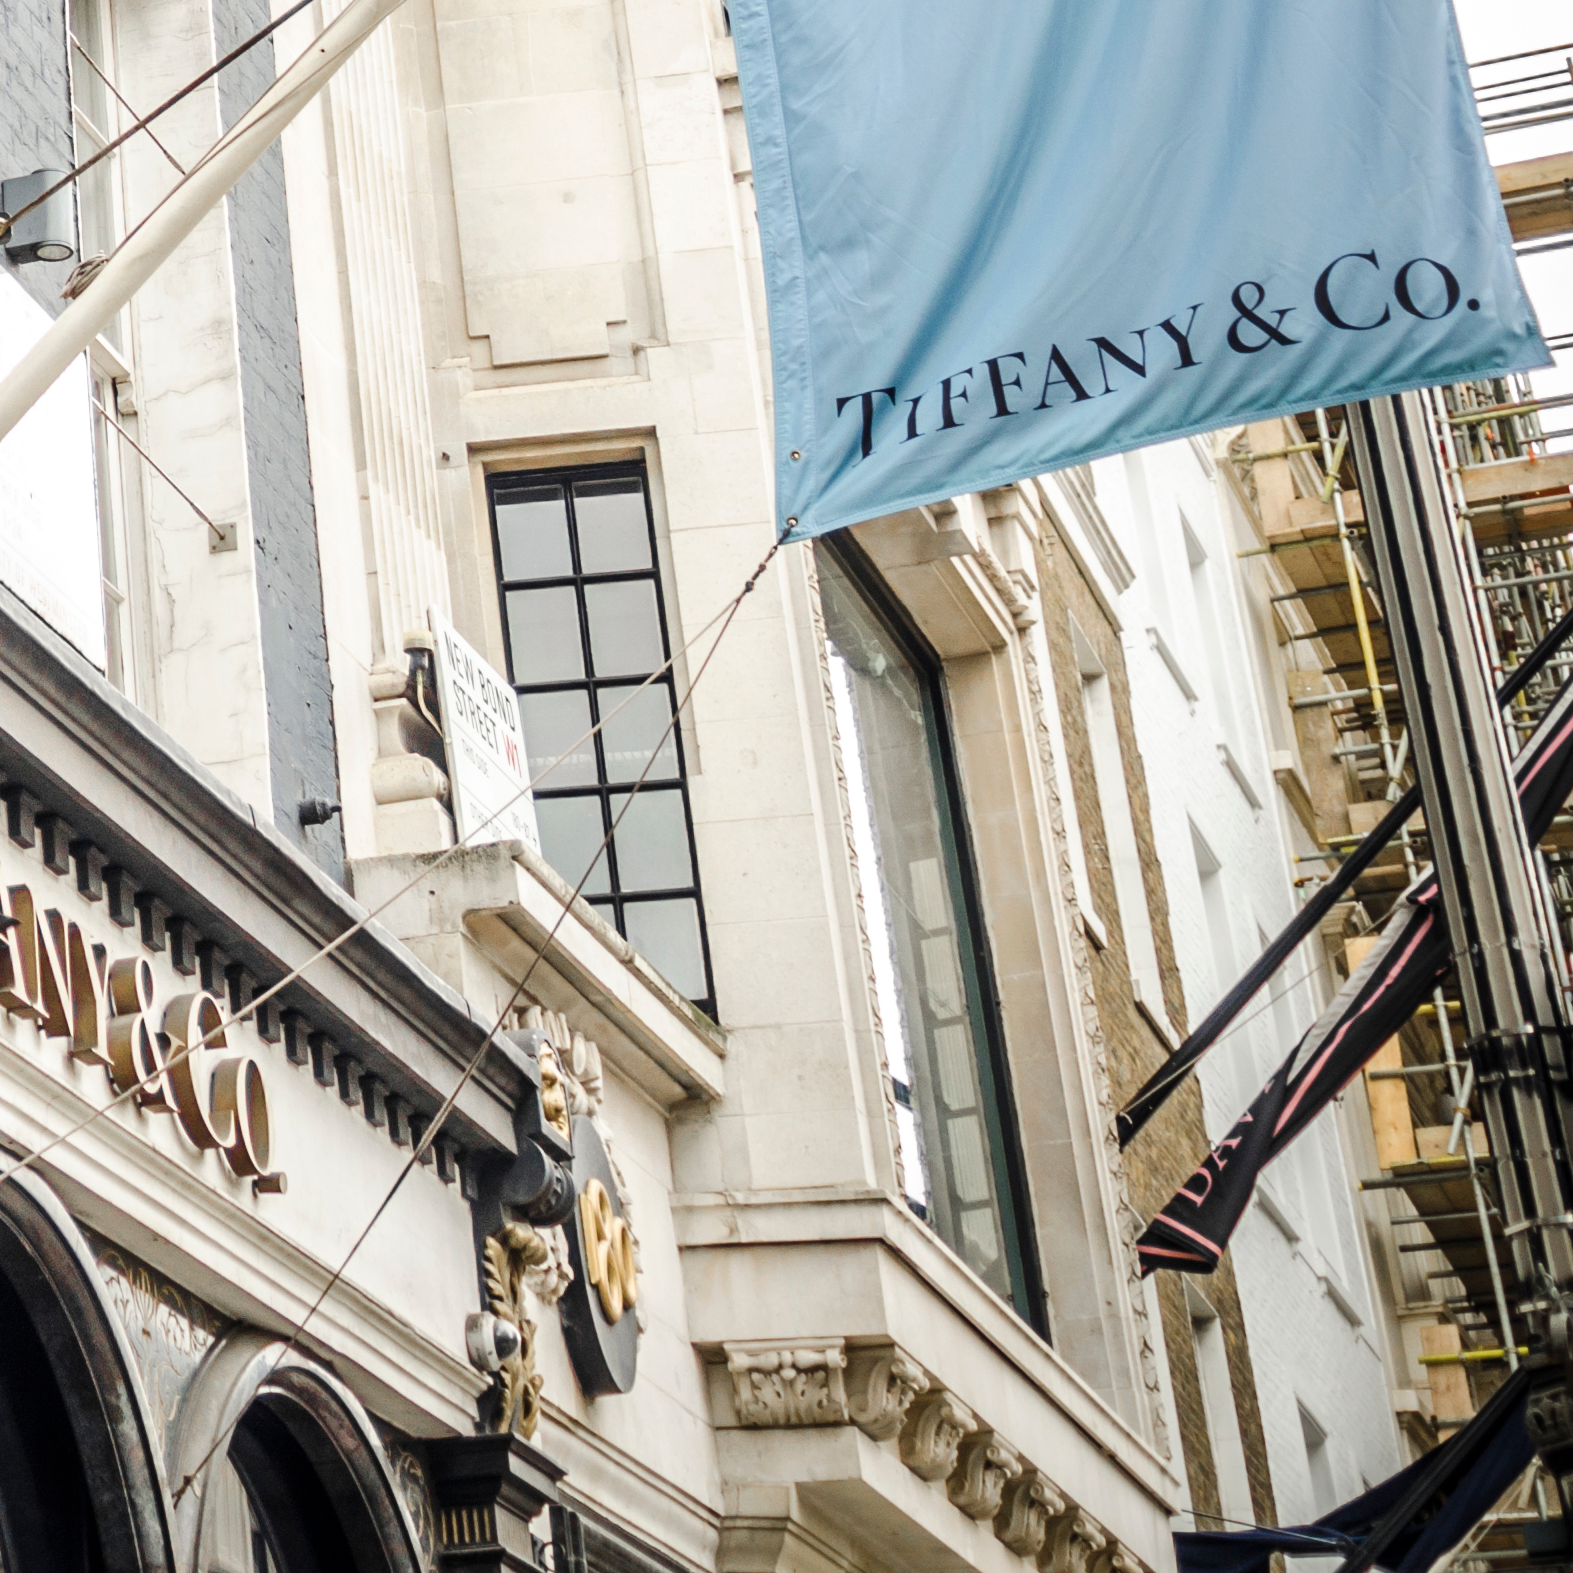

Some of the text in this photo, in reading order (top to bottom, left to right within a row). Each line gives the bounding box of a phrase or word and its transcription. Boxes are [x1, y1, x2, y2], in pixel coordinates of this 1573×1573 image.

[836, 302, 1205, 469] TIFFANY
[444, 630, 517, 733] NEW BOND
[452, 679, 523, 778] STREET W1
